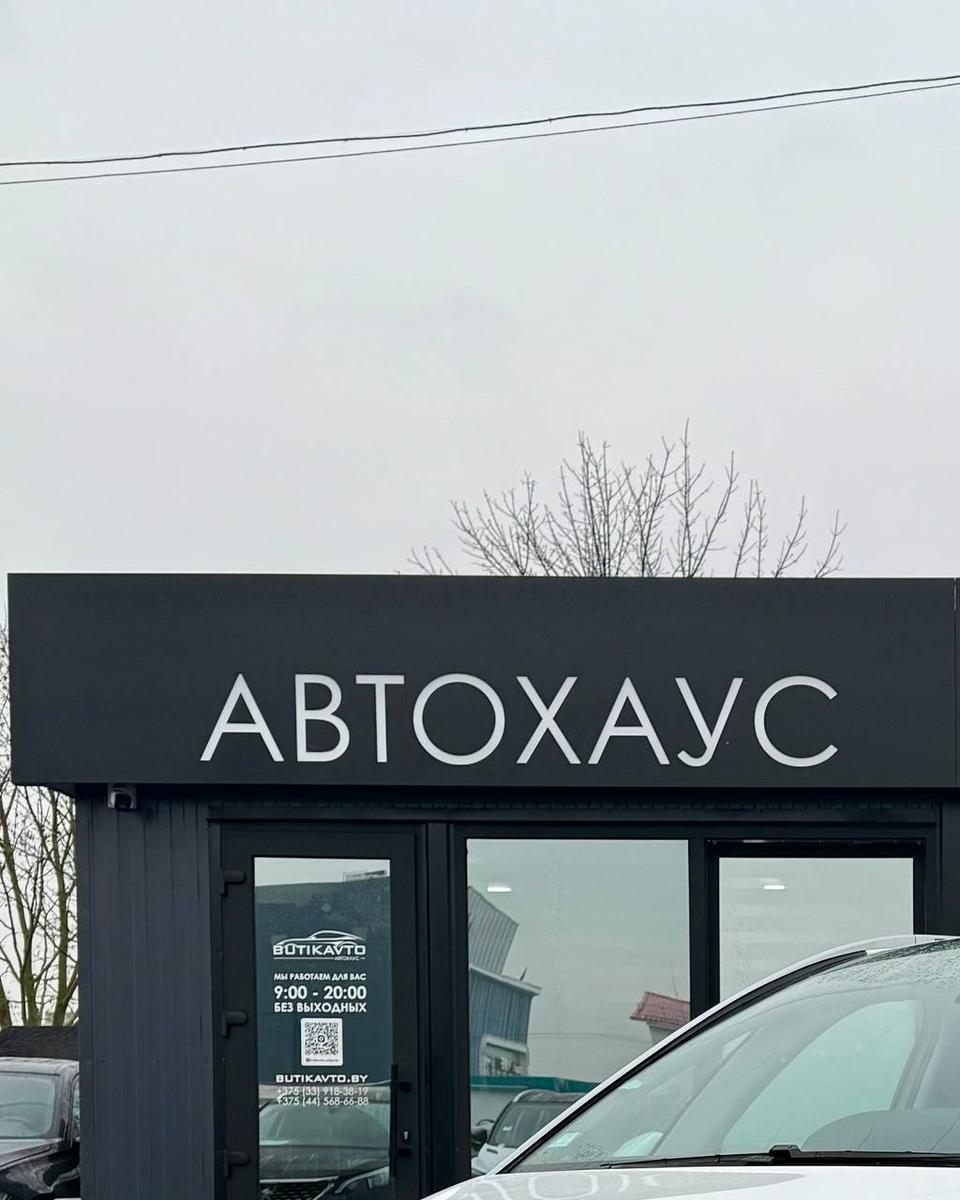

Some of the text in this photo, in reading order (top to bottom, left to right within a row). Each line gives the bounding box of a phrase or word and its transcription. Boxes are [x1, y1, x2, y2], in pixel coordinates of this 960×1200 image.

[200, 673, 838, 767] АВТОХАУС
[272, 945, 366, 956] BUTIKAVTO
[273, 973, 367, 982] МЫ РАБОТАЕМ ДЛЯ ВАС
[273, 985, 308, 1000] 9:00
[323, 985, 368, 1000] 20:00
[274, 1002, 367, 1014] БЕЗ ВЫХОДНЫХ
[275, 1074, 368, 1083] BUTIKAVTO.BY
[302, 1086, 320, 1097] (33)
[322, 1086, 369, 1096] 918-38-19
[302, 1096, 320, 1107] (44)
[323, 1096, 369, 1106] 568-66-88
